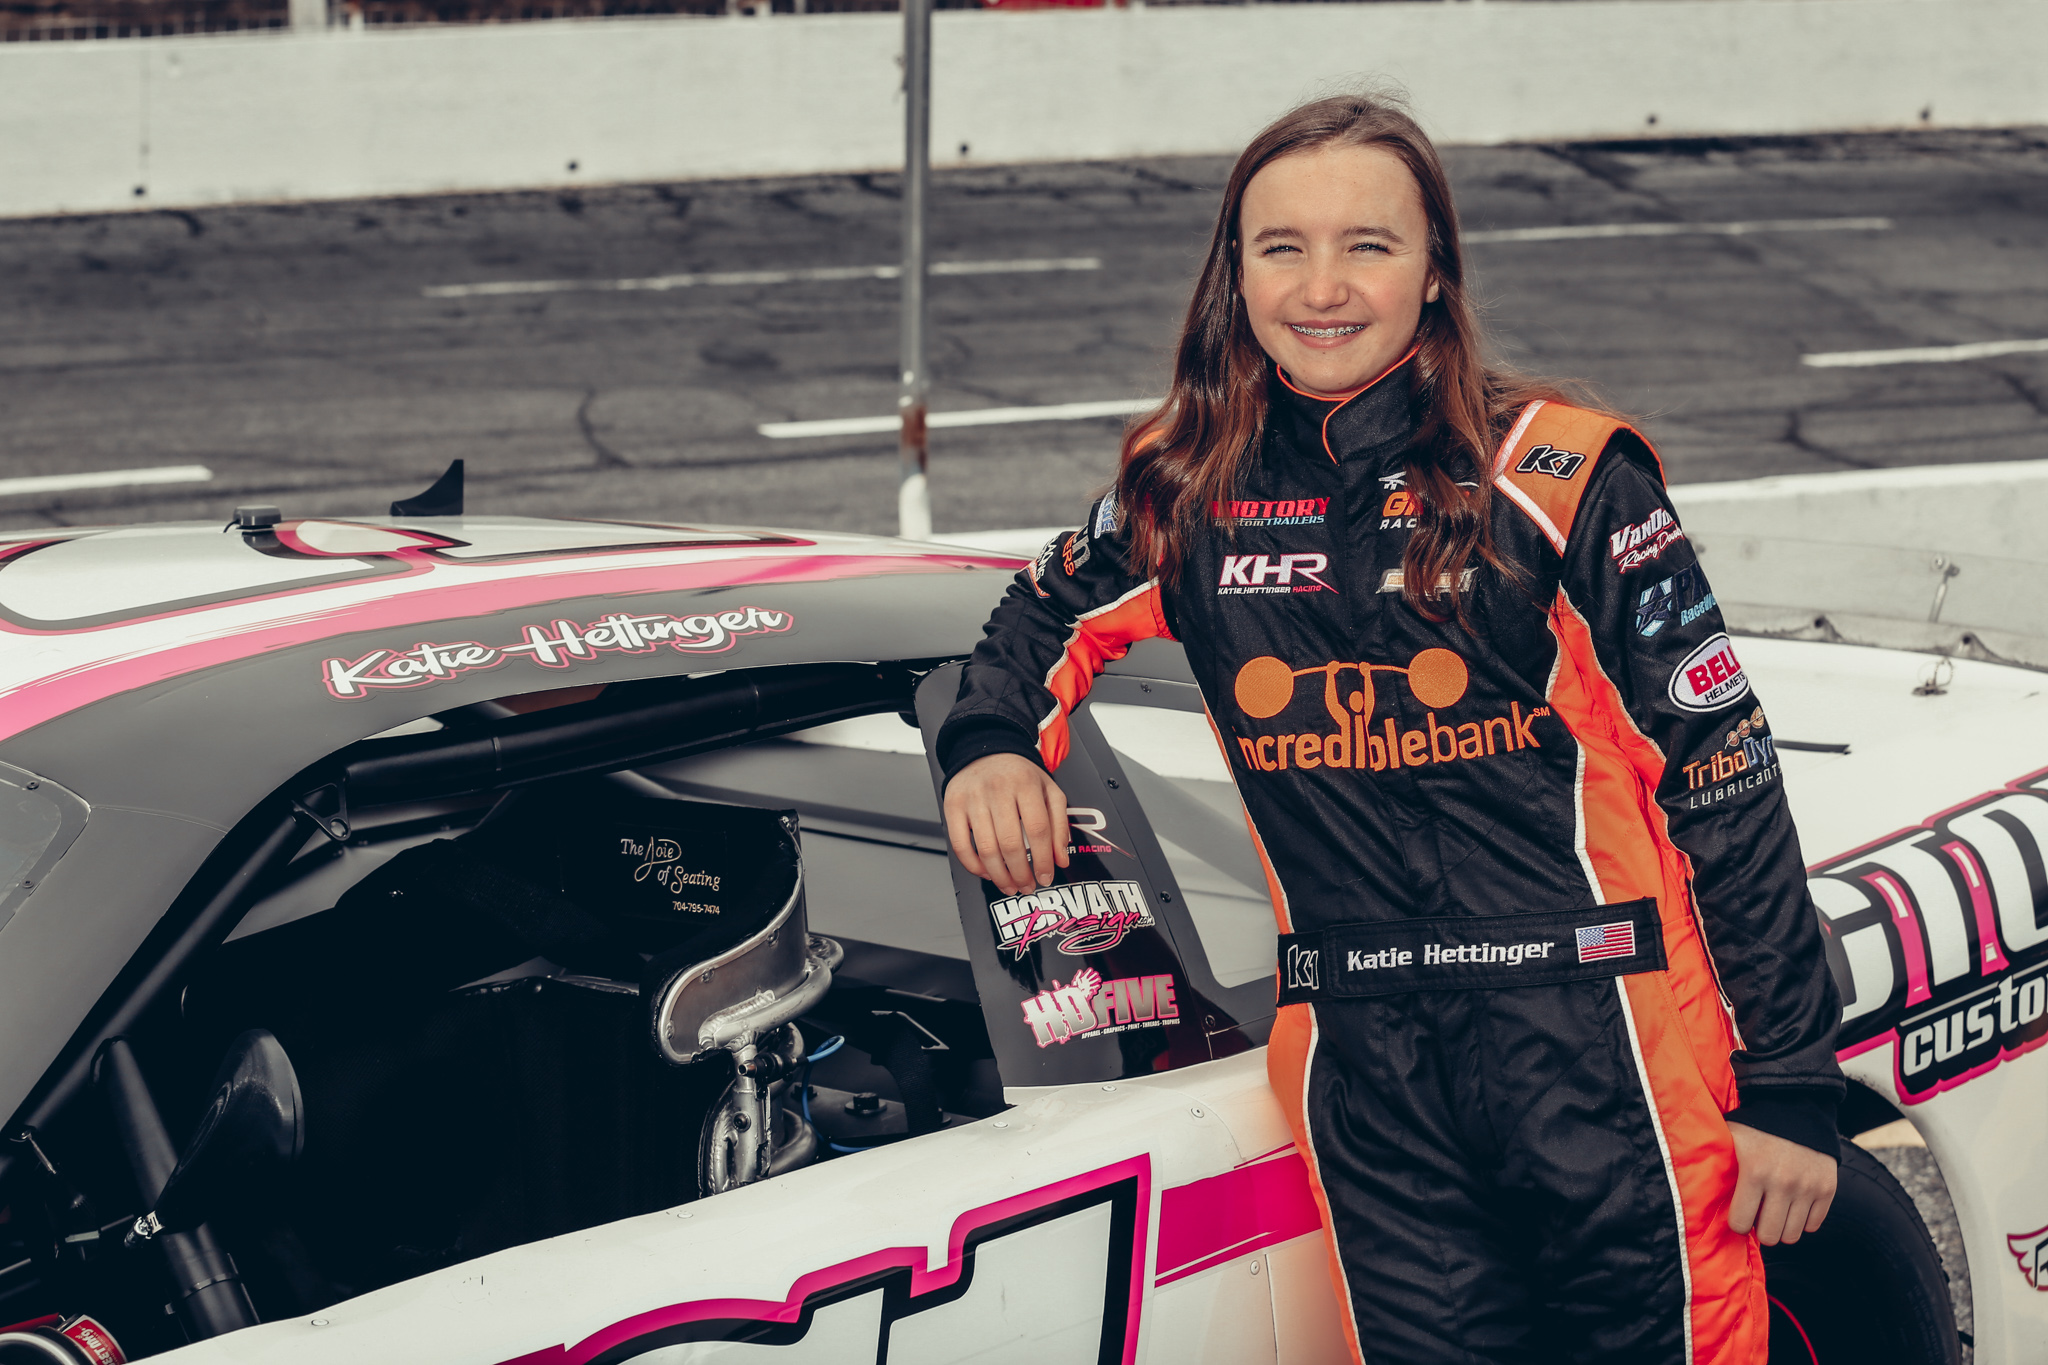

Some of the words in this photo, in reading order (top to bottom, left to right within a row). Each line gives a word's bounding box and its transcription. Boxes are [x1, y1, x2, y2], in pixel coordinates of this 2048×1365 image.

[1515, 444, 1586, 480] K1
[1266, 515, 1325, 526] TRAILERS
[1379, 518, 1418, 530] RAC
[1219, 552, 1339, 594] KHR
[1620, 543, 1661, 574] Racing
[1292, 585, 1322, 593] RACING
[330, 643, 500, 695] Katie
[501, 607, 784, 664] Hettinger
[1686, 645, 1741, 697] BELL
[1704, 671, 1746, 703] HELMETS
[1233, 701, 1541, 772] ncrediblebank
[621, 838, 644, 856] The
[1078, 845, 1112, 853] RACING
[657, 865, 672, 886] of
[670, 866, 721, 894] Seating
[672, 901, 720, 915] 704-795-7474
[993, 882, 1150, 940] HORVATH
[1001, 906, 1141, 955] Design
[1346, 946, 1413, 972] Katie
[1423, 939, 1555, 966] Hettinger
[1103, 1025, 1126, 1034] GRAPHICS
[1128, 1023, 1140, 1031] PRINT
[1904, 974, 2048, 1077] custo
